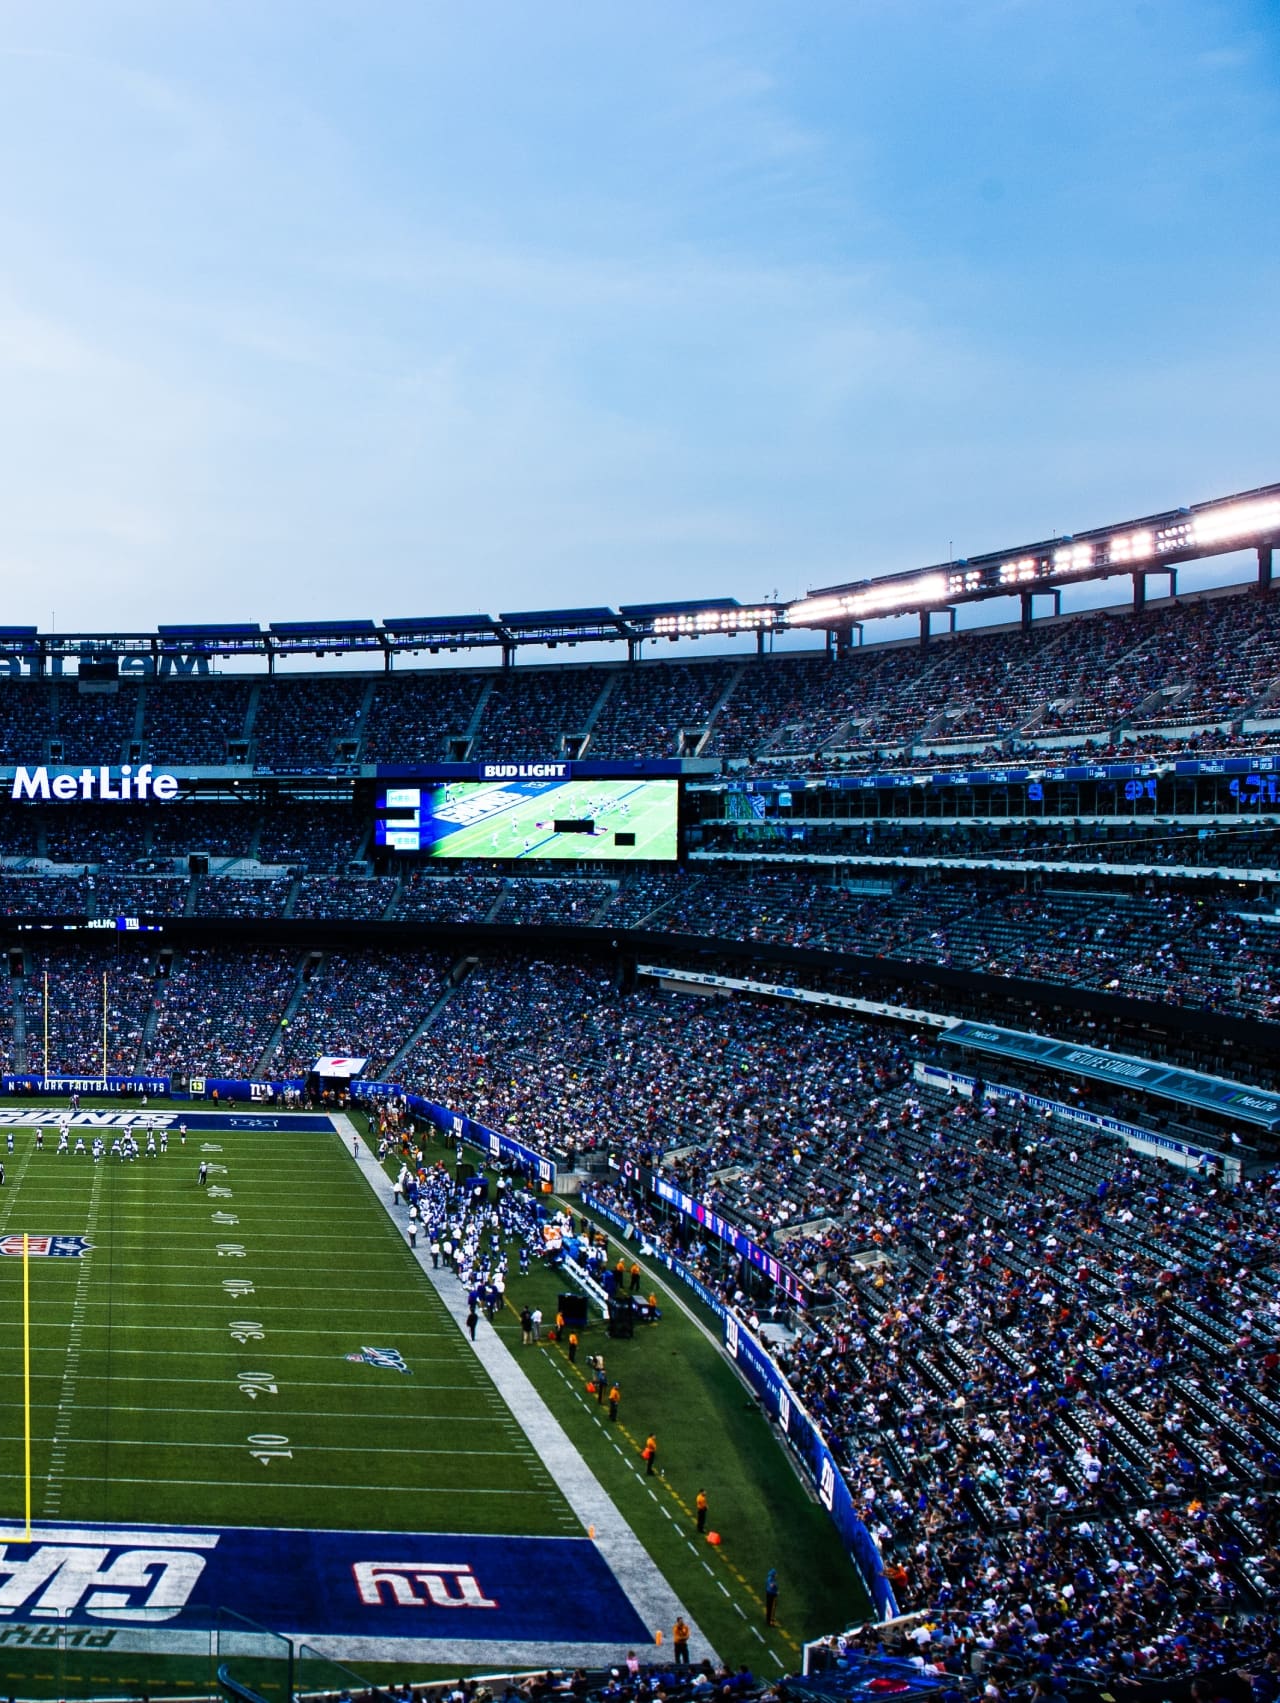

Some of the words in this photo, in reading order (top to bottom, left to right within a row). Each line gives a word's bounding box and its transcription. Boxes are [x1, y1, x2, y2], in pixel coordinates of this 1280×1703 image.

[484, 764, 519, 777] BUD
[519, 764, 567, 777] LIGHT
[11, 764, 179, 799] MetLife
[972, 1030, 1000, 1041] MetLife
[1063, 1050, 1107, 1070] METLIFE
[1102, 1057, 1150, 1078] STADIUM
[37, 1081, 63, 1091] YORK
[192, 1081, 202, 1091] 13
[1239, 1094, 1278, 1112] MetLife
[216, 1244, 246, 1257] 50
[222, 1279, 256, 1295] 40
[229, 1321, 266, 1340] 30
[237, 1372, 278, 1394] 20
[726, 1314, 738, 1359] ny
[779, 1388, 790, 1433] ny
[247, 1434, 293, 1459] 10
[819, 1457, 835, 1512] ny
[353, 1562, 500, 1608] ny
